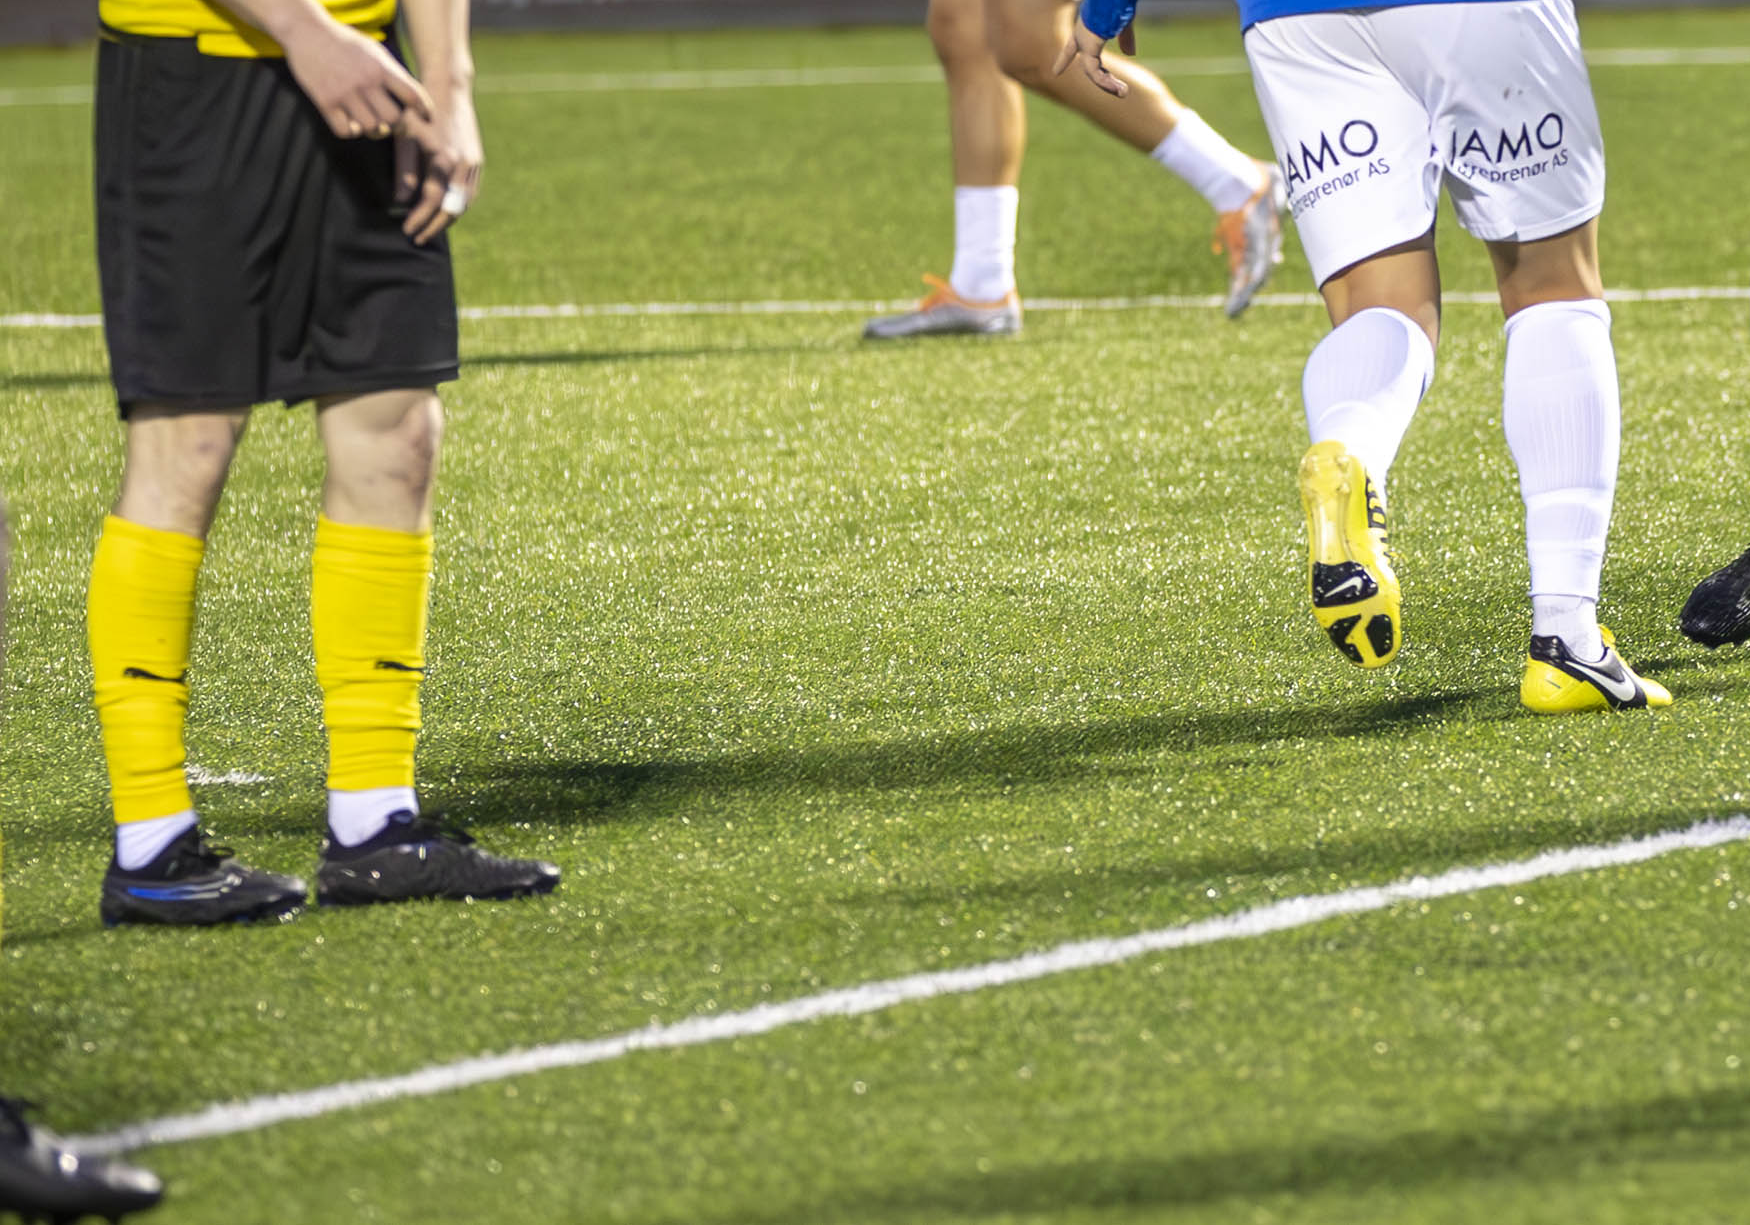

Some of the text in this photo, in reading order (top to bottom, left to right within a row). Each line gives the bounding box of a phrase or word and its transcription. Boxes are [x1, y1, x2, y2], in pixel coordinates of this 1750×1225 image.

[1286, 119, 1379, 199] AMO
[1367, 158, 1391, 178] AS
[1552, 148, 1569, 171] AS
